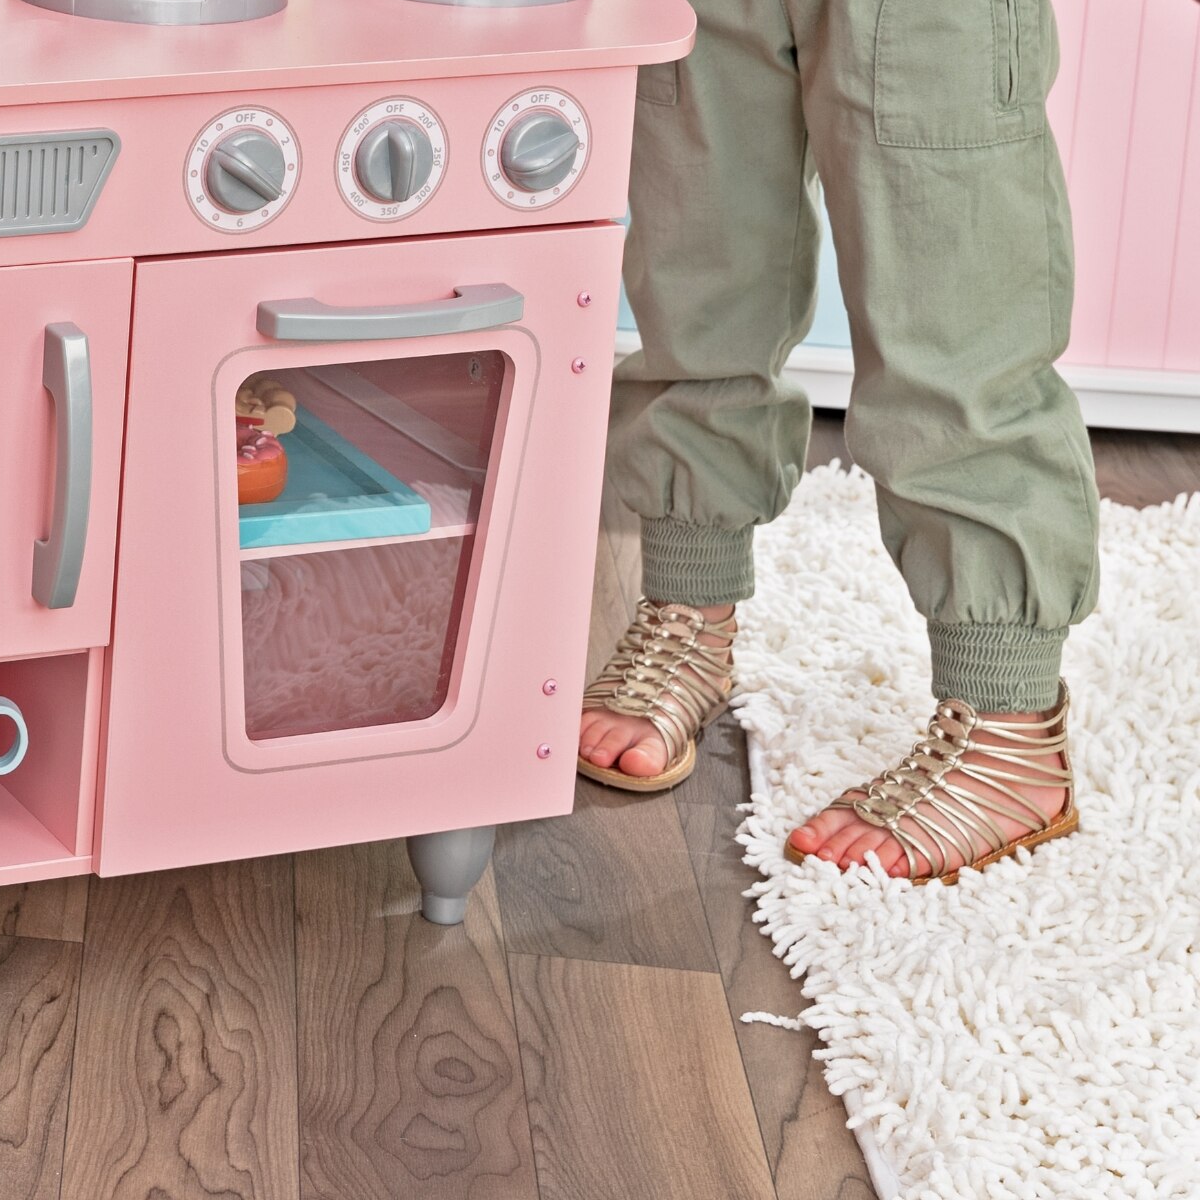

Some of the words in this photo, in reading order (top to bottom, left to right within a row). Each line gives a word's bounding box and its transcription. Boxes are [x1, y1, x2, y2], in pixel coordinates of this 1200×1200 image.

[530, 94, 550, 103] OFF
[385, 104, 404, 113] OFF
[235, 113, 256, 123] OFF
[572, 117, 581, 126] 2
[494, 119, 506, 133] 10
[281, 136, 290, 146] 2
[197, 139, 209, 153] 10
[492, 173, 501, 182] 8
[196, 194, 205, 203] 8
[530, 196, 536, 204] 6
[236, 218, 243, 227] 6
